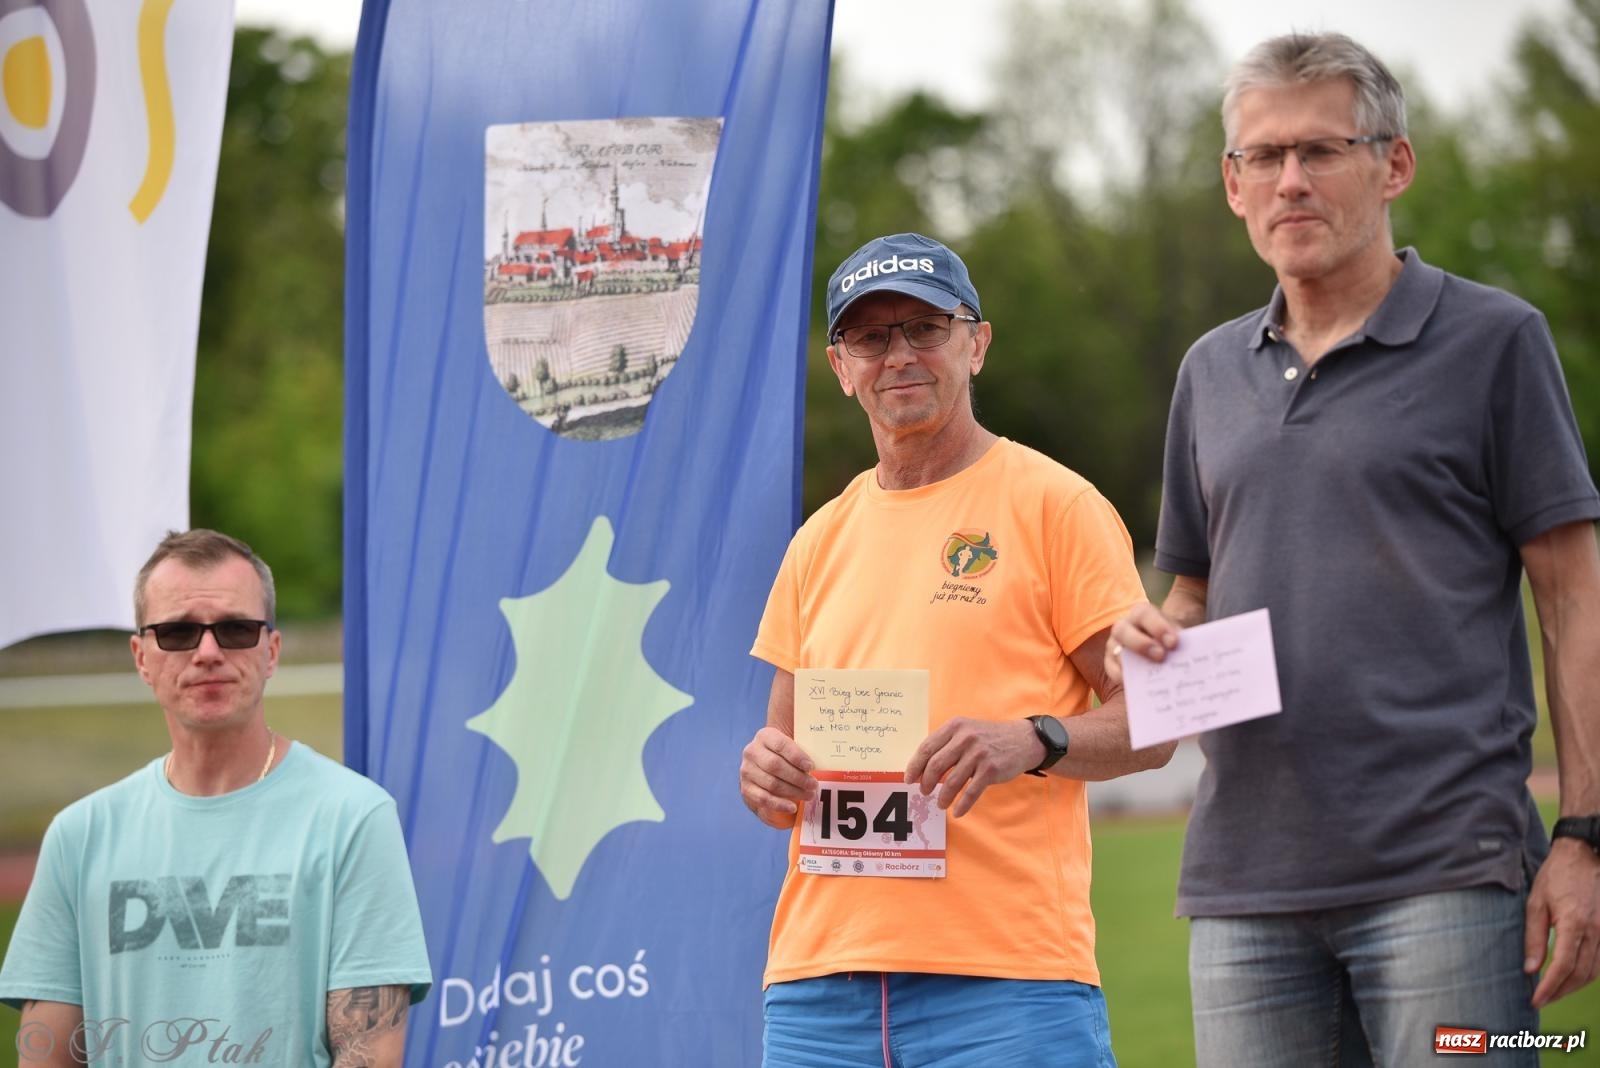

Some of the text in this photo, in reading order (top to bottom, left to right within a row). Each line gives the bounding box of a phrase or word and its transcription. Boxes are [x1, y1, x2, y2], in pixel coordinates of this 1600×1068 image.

[841, 255, 935, 293] adidas
[941, 580, 982, 599] biegniemy
[976, 596, 987, 605] 20
[809, 683, 825, 699] XVI
[820, 789, 913, 842] 154
[569, 949, 650, 999] coś
